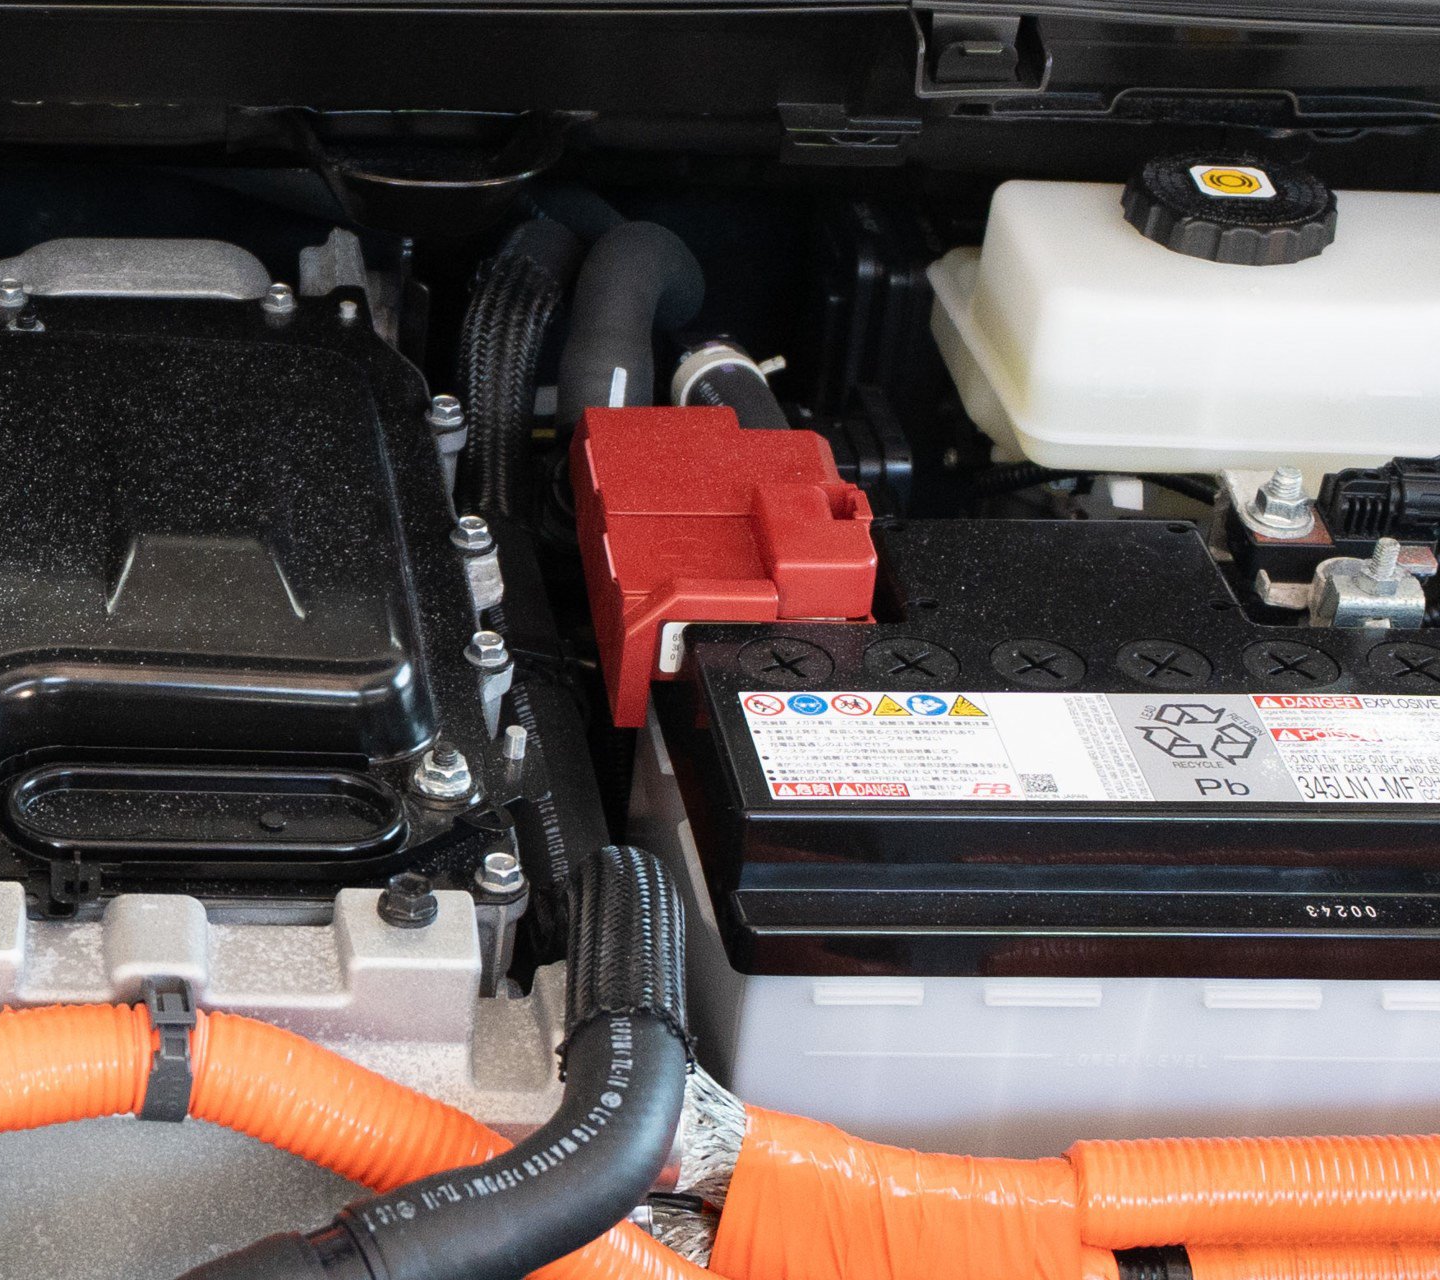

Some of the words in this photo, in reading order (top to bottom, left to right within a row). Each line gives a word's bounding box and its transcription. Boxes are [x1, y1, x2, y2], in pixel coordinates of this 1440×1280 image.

[1280, 696, 1363, 709] DANGER
[1139, 704, 1157, 721] LEAD
[1226, 712, 1267, 738] RETURN
[1172, 760, 1225, 769] RECYCLE
[1284, 754, 1299, 764] DO
[1301, 755, 1320, 764] NOT
[1369, 755, 1390, 765] OUT
[1315, 764, 1341, 773] VENT
[1343, 764, 1370, 774] CAPS
[1372, 765, 1403, 774] TIGHT
[1405, 765, 1424, 774] AND
[795, 784, 833, 796] 危険
[855, 784, 910, 796] DANGER
[1194, 778, 1250, 796] Pb
[1298, 775, 1415, 800] 345LN1-MF
[1305, 904, 1378, 919] 00243
[522, 1136, 579, 1178] WATER
